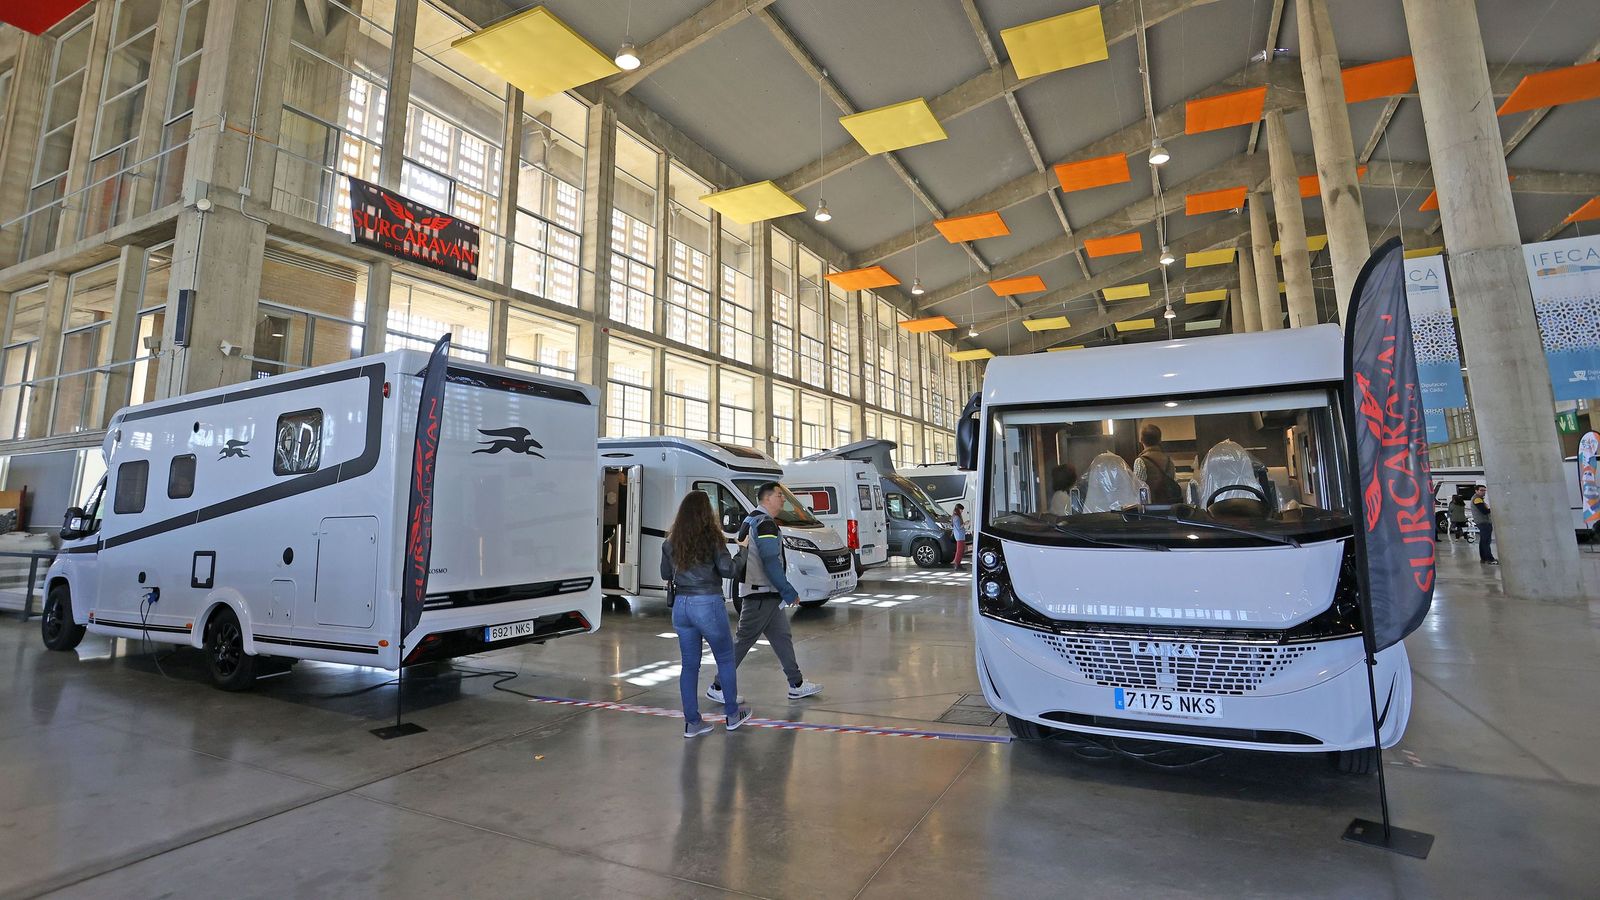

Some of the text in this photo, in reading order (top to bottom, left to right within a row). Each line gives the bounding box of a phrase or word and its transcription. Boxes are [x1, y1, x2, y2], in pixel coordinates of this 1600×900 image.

[353, 209, 475, 264] SURCARAVAN
[384, 241, 445, 266] PREMIUM
[1532, 247, 1600, 267] IFECA
[492, 623, 531, 639] 6921 NKS
[1126, 691, 1216, 714] 7175 NKS
